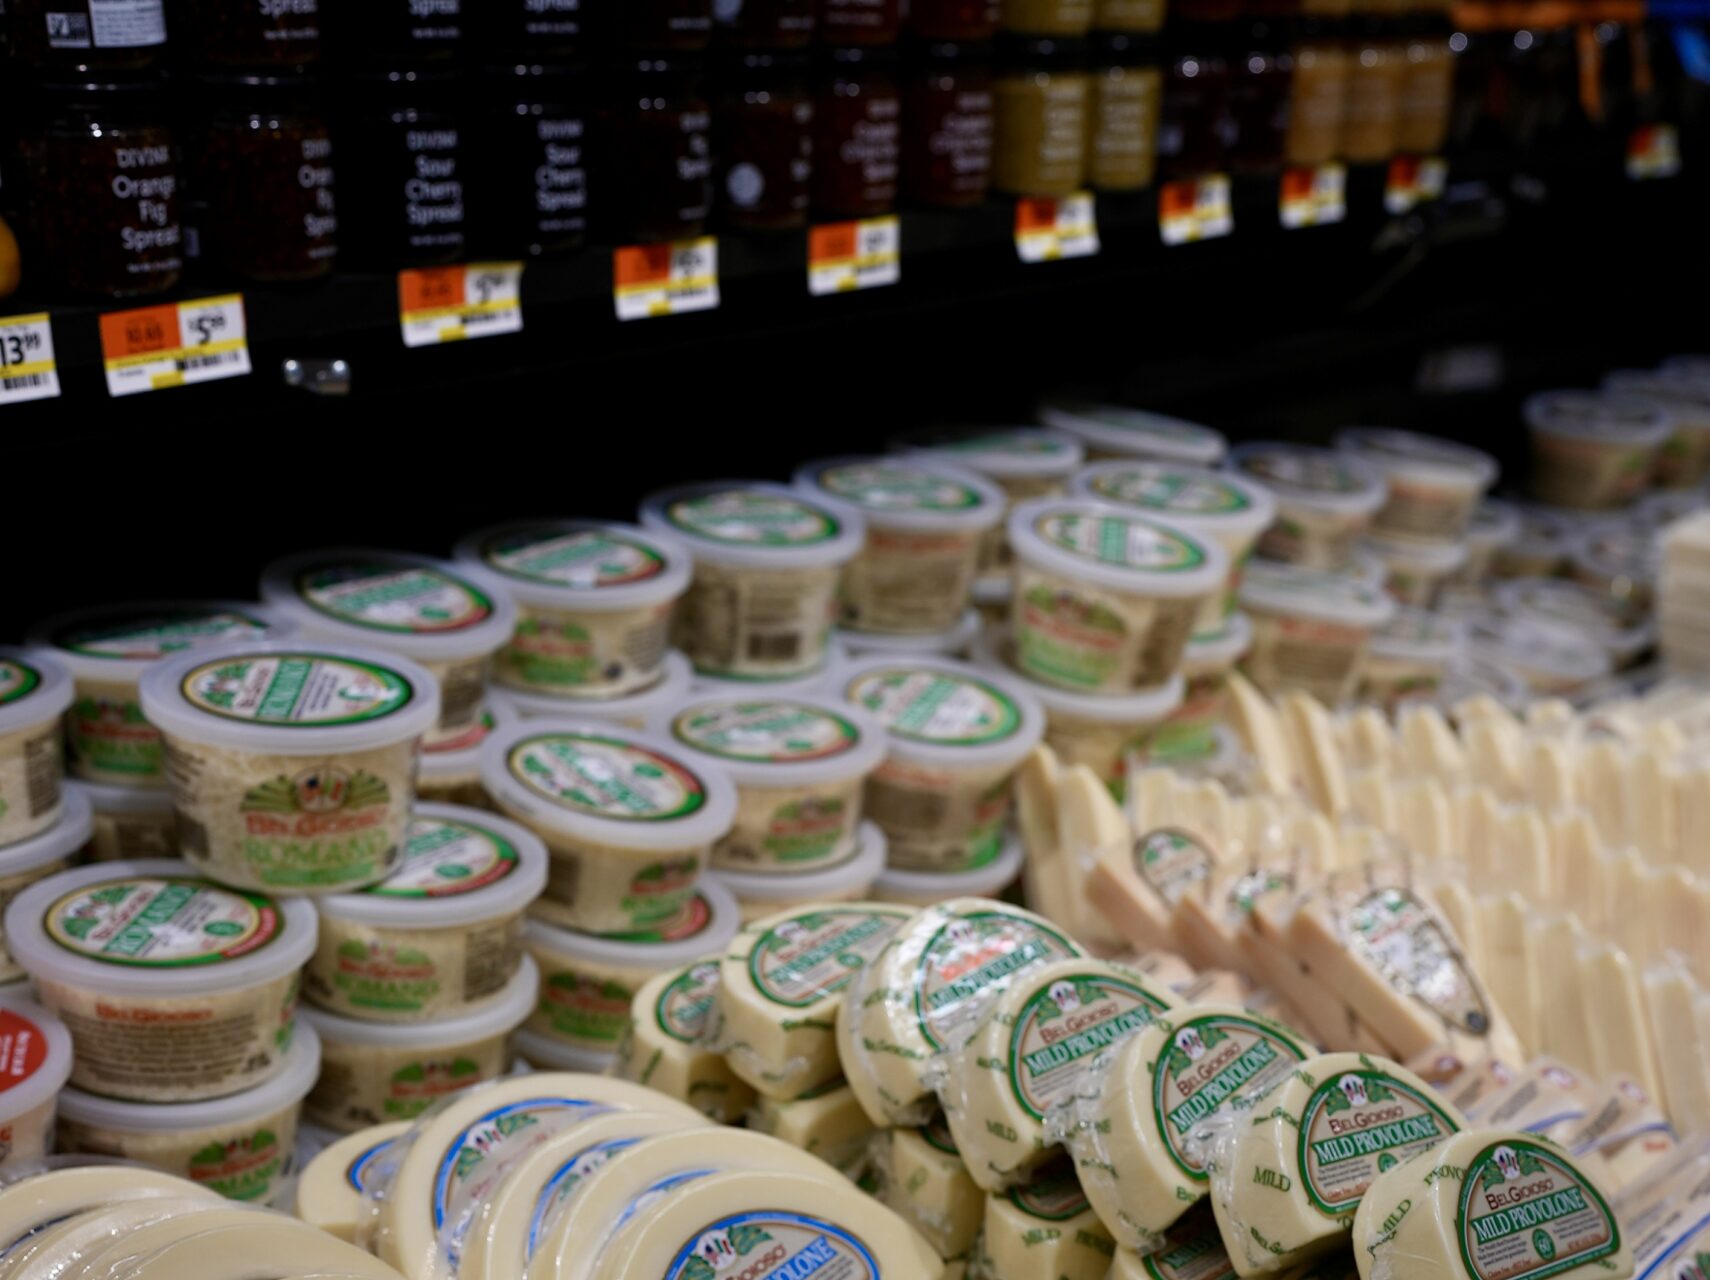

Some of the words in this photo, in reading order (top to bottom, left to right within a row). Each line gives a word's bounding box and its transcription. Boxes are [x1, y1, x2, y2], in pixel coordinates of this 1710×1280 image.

[1025, 1046, 1069, 1076] MILD
[1066, 1006, 1152, 1063] PROVOLONE
[1171, 1092, 1208, 1132] MILD
[1203, 1040, 1277, 1112] PROVOLONE
[1176, 1042, 1242, 1098] BELGIOIOSO
[1314, 1135, 1353, 1165] MILD
[1354, 1115, 1437, 1154] PROVOLONE
[1328, 1106, 1404, 1136] BELGIOIOSO
[1253, 1166, 1291, 1193] MILD
[1485, 1178, 1554, 1211] BELGIOIOSO
[1473, 1211, 1512, 1242] MILD
[1510, 1190, 1585, 1230] PROVOLONE
